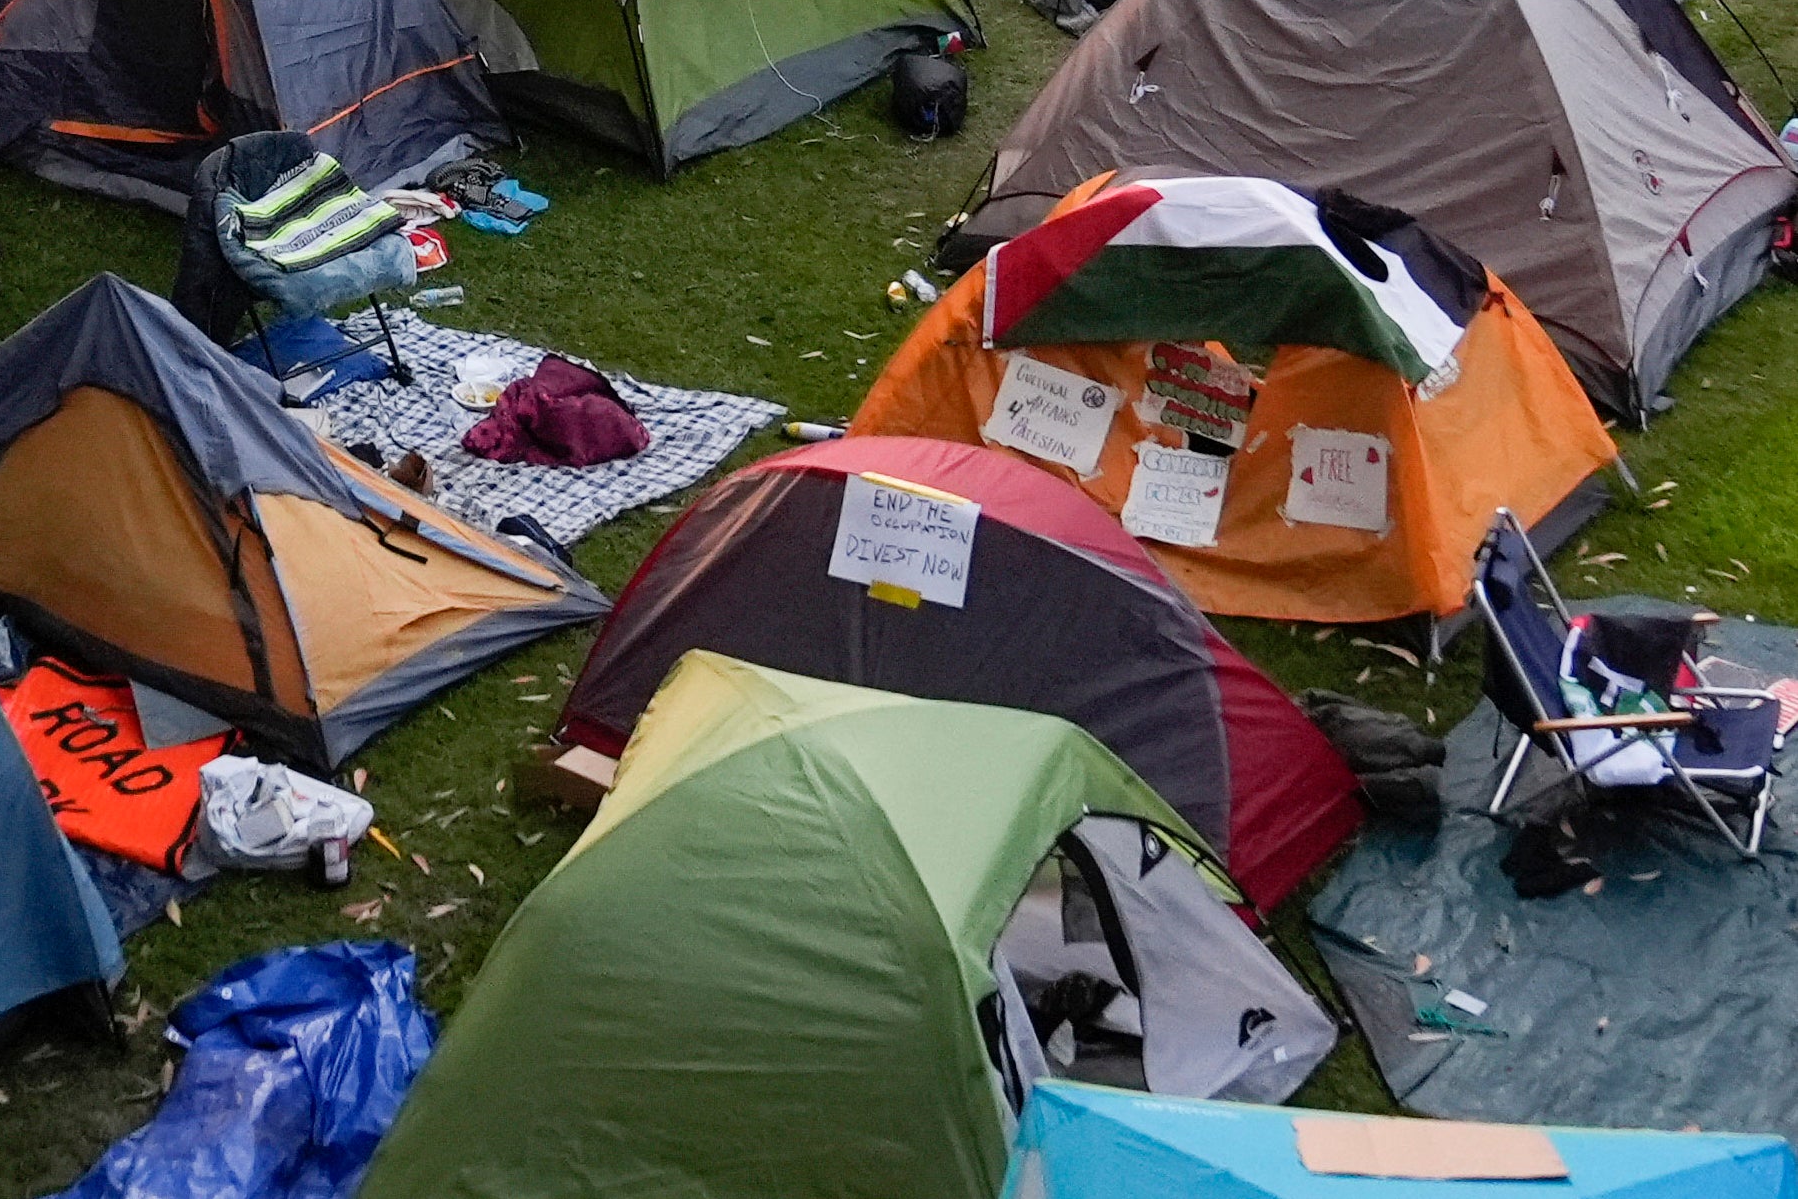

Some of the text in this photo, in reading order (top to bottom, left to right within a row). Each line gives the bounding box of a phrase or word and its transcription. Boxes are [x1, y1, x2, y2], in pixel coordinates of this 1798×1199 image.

[1319, 448, 1355, 484] FREE
[873, 488, 953, 523] END THE
[870, 513, 971, 545] OCCUPATION
[845, 533, 963, 582] DIVEST NOW
[29, 701, 174, 795] ROAD
